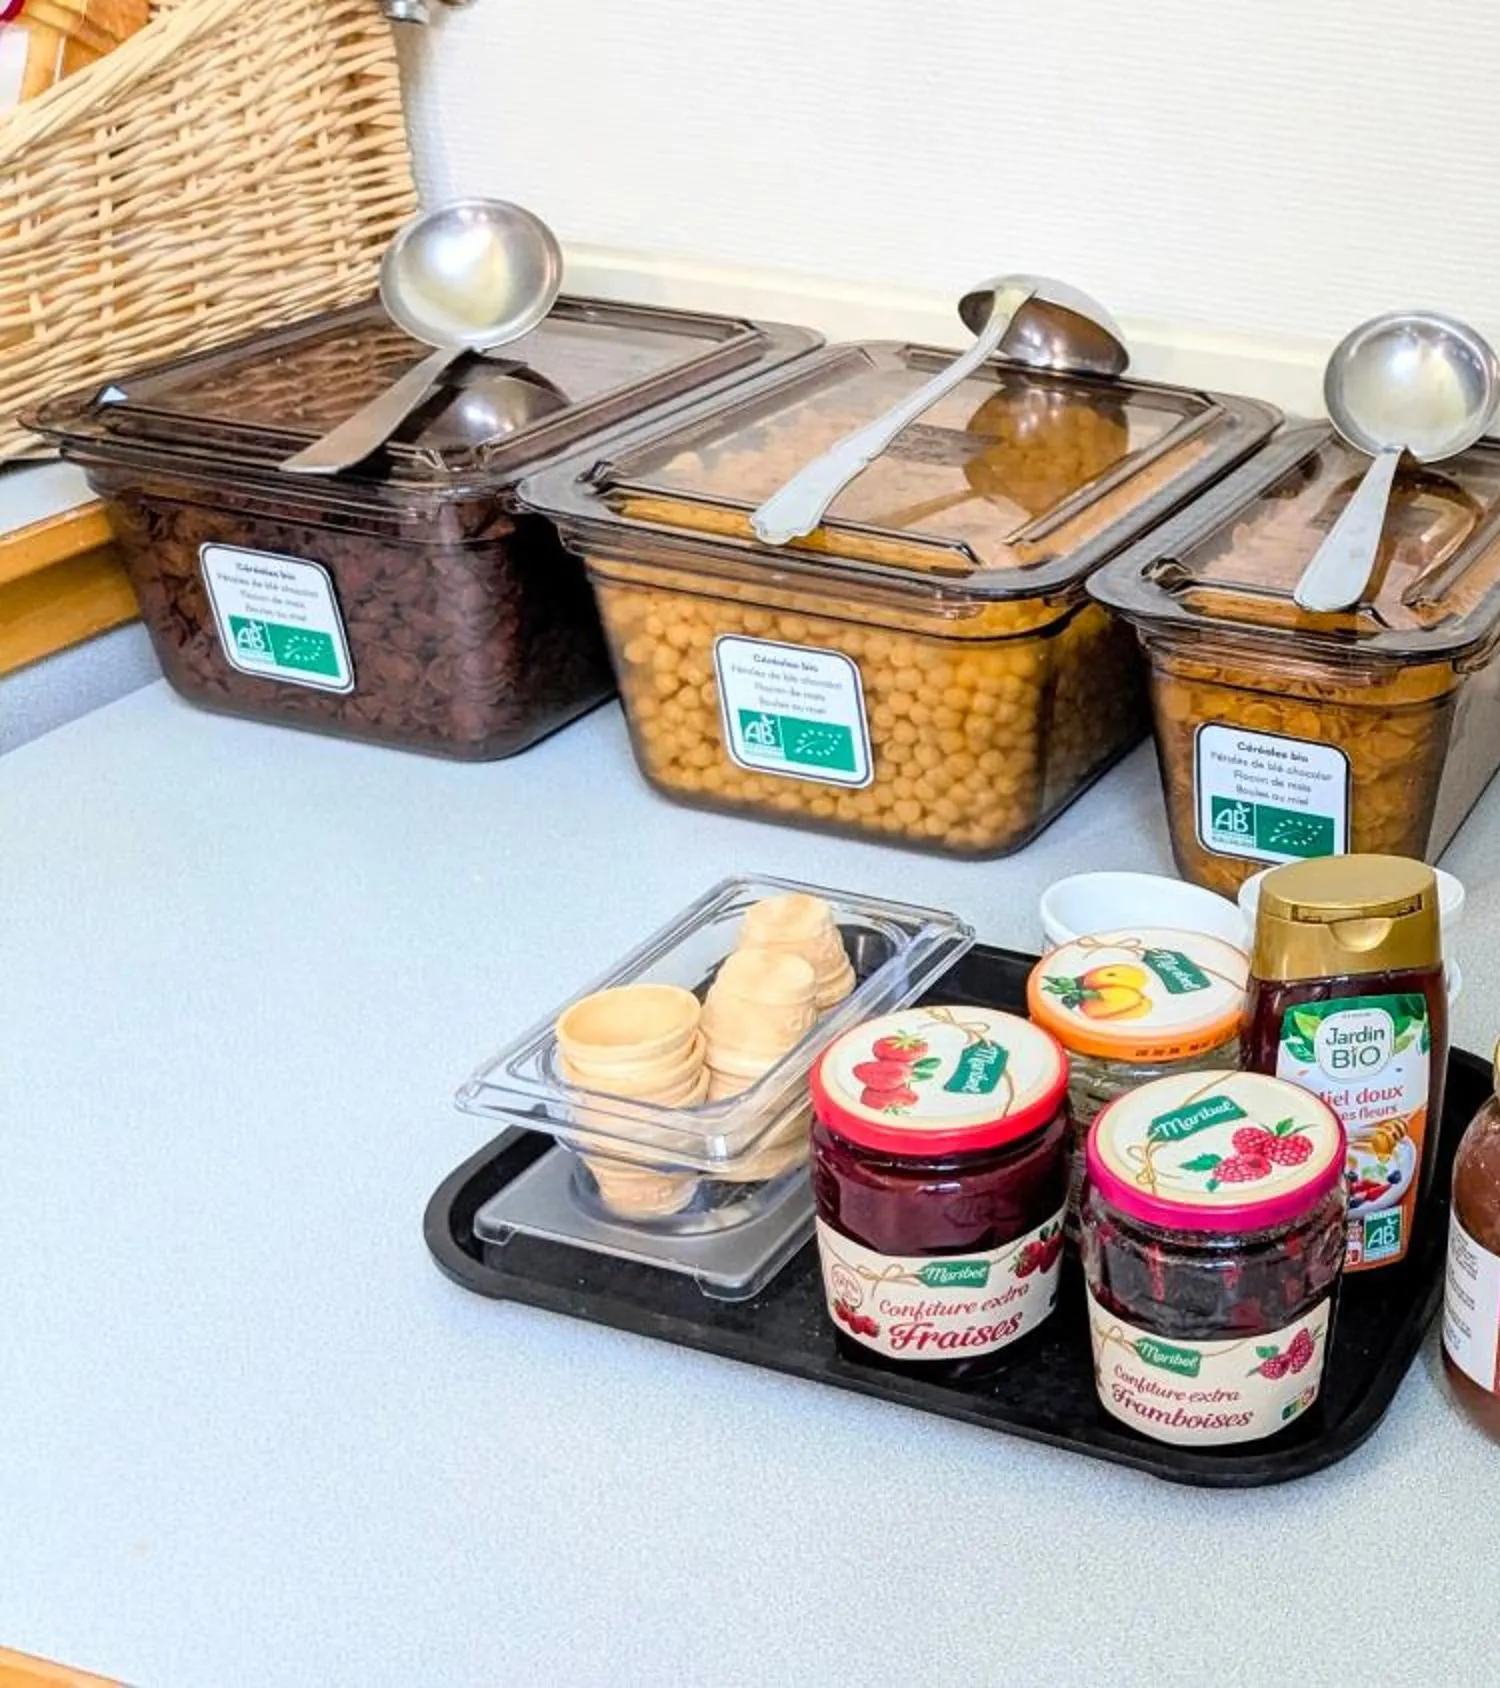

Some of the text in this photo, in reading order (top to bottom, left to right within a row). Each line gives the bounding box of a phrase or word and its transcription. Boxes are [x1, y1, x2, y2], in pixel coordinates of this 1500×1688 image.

[1290, 751, 1309, 763] bio
[1325, 1026, 1385, 1045] Jardin
[1356, 1085, 1404, 1105] doux
[1153, 1099, 1235, 1138] Maribel
[1359, 1104, 1398, 1120] fleurs
[1367, 1224, 1397, 1249] AB
[924, 1263, 989, 1283] Maribel
[879, 1283, 1030, 1321] Confiture extra
[888, 1311, 1024, 1350] Fraises
[1139, 1339, 1197, 1367] Maribel
[1114, 1364, 1240, 1403] Confiture extra
[1111, 1383, 1254, 1429] Framboises
